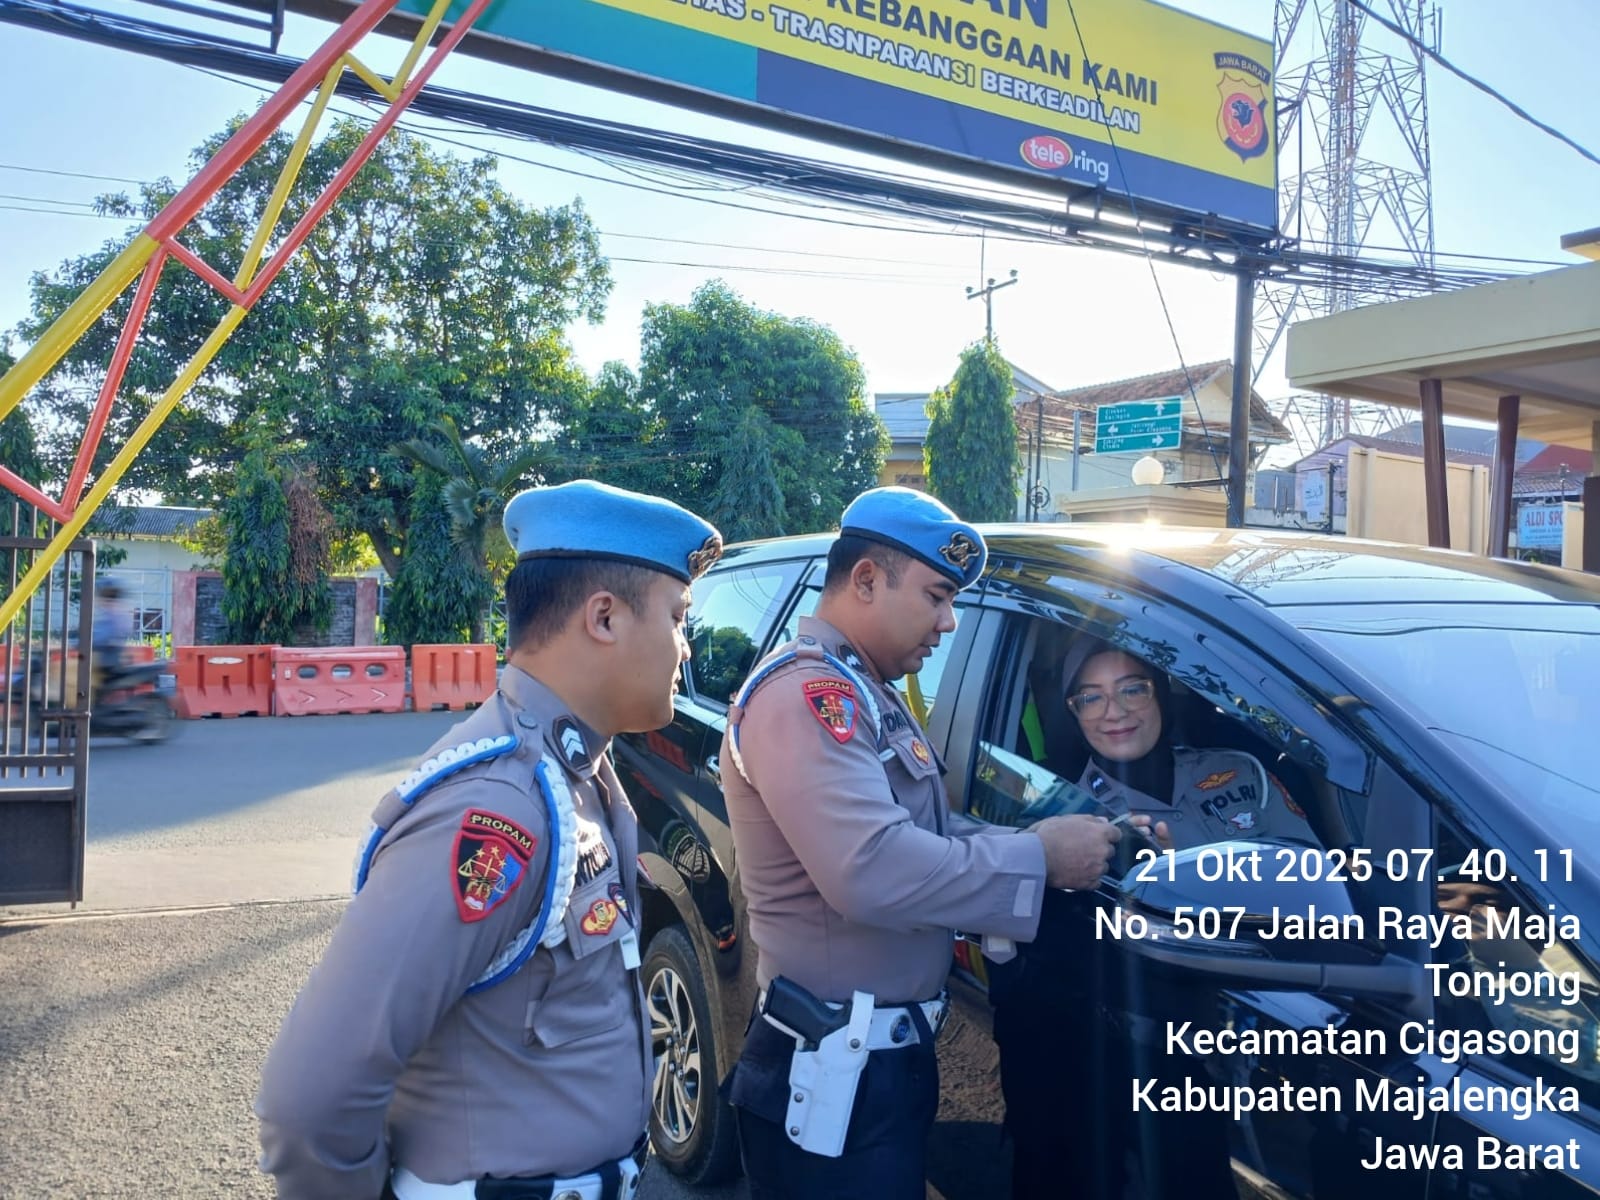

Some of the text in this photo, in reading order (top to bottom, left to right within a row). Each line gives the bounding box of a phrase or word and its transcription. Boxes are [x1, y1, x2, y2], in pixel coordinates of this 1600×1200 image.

[769, 4, 976, 88] TRASNPARANSI
[981, 67, 1141, 135] BERKEADILAN
[1082, 58, 1159, 106] KAMI
[1218, 55, 1267, 79] JAWA BARAT
[1030, 139, 1109, 182] tele ring
[1525, 511, 1545, 526] ALDI
[806, 680, 851, 691] PROPAM
[469, 813, 533, 850] PROPAM
